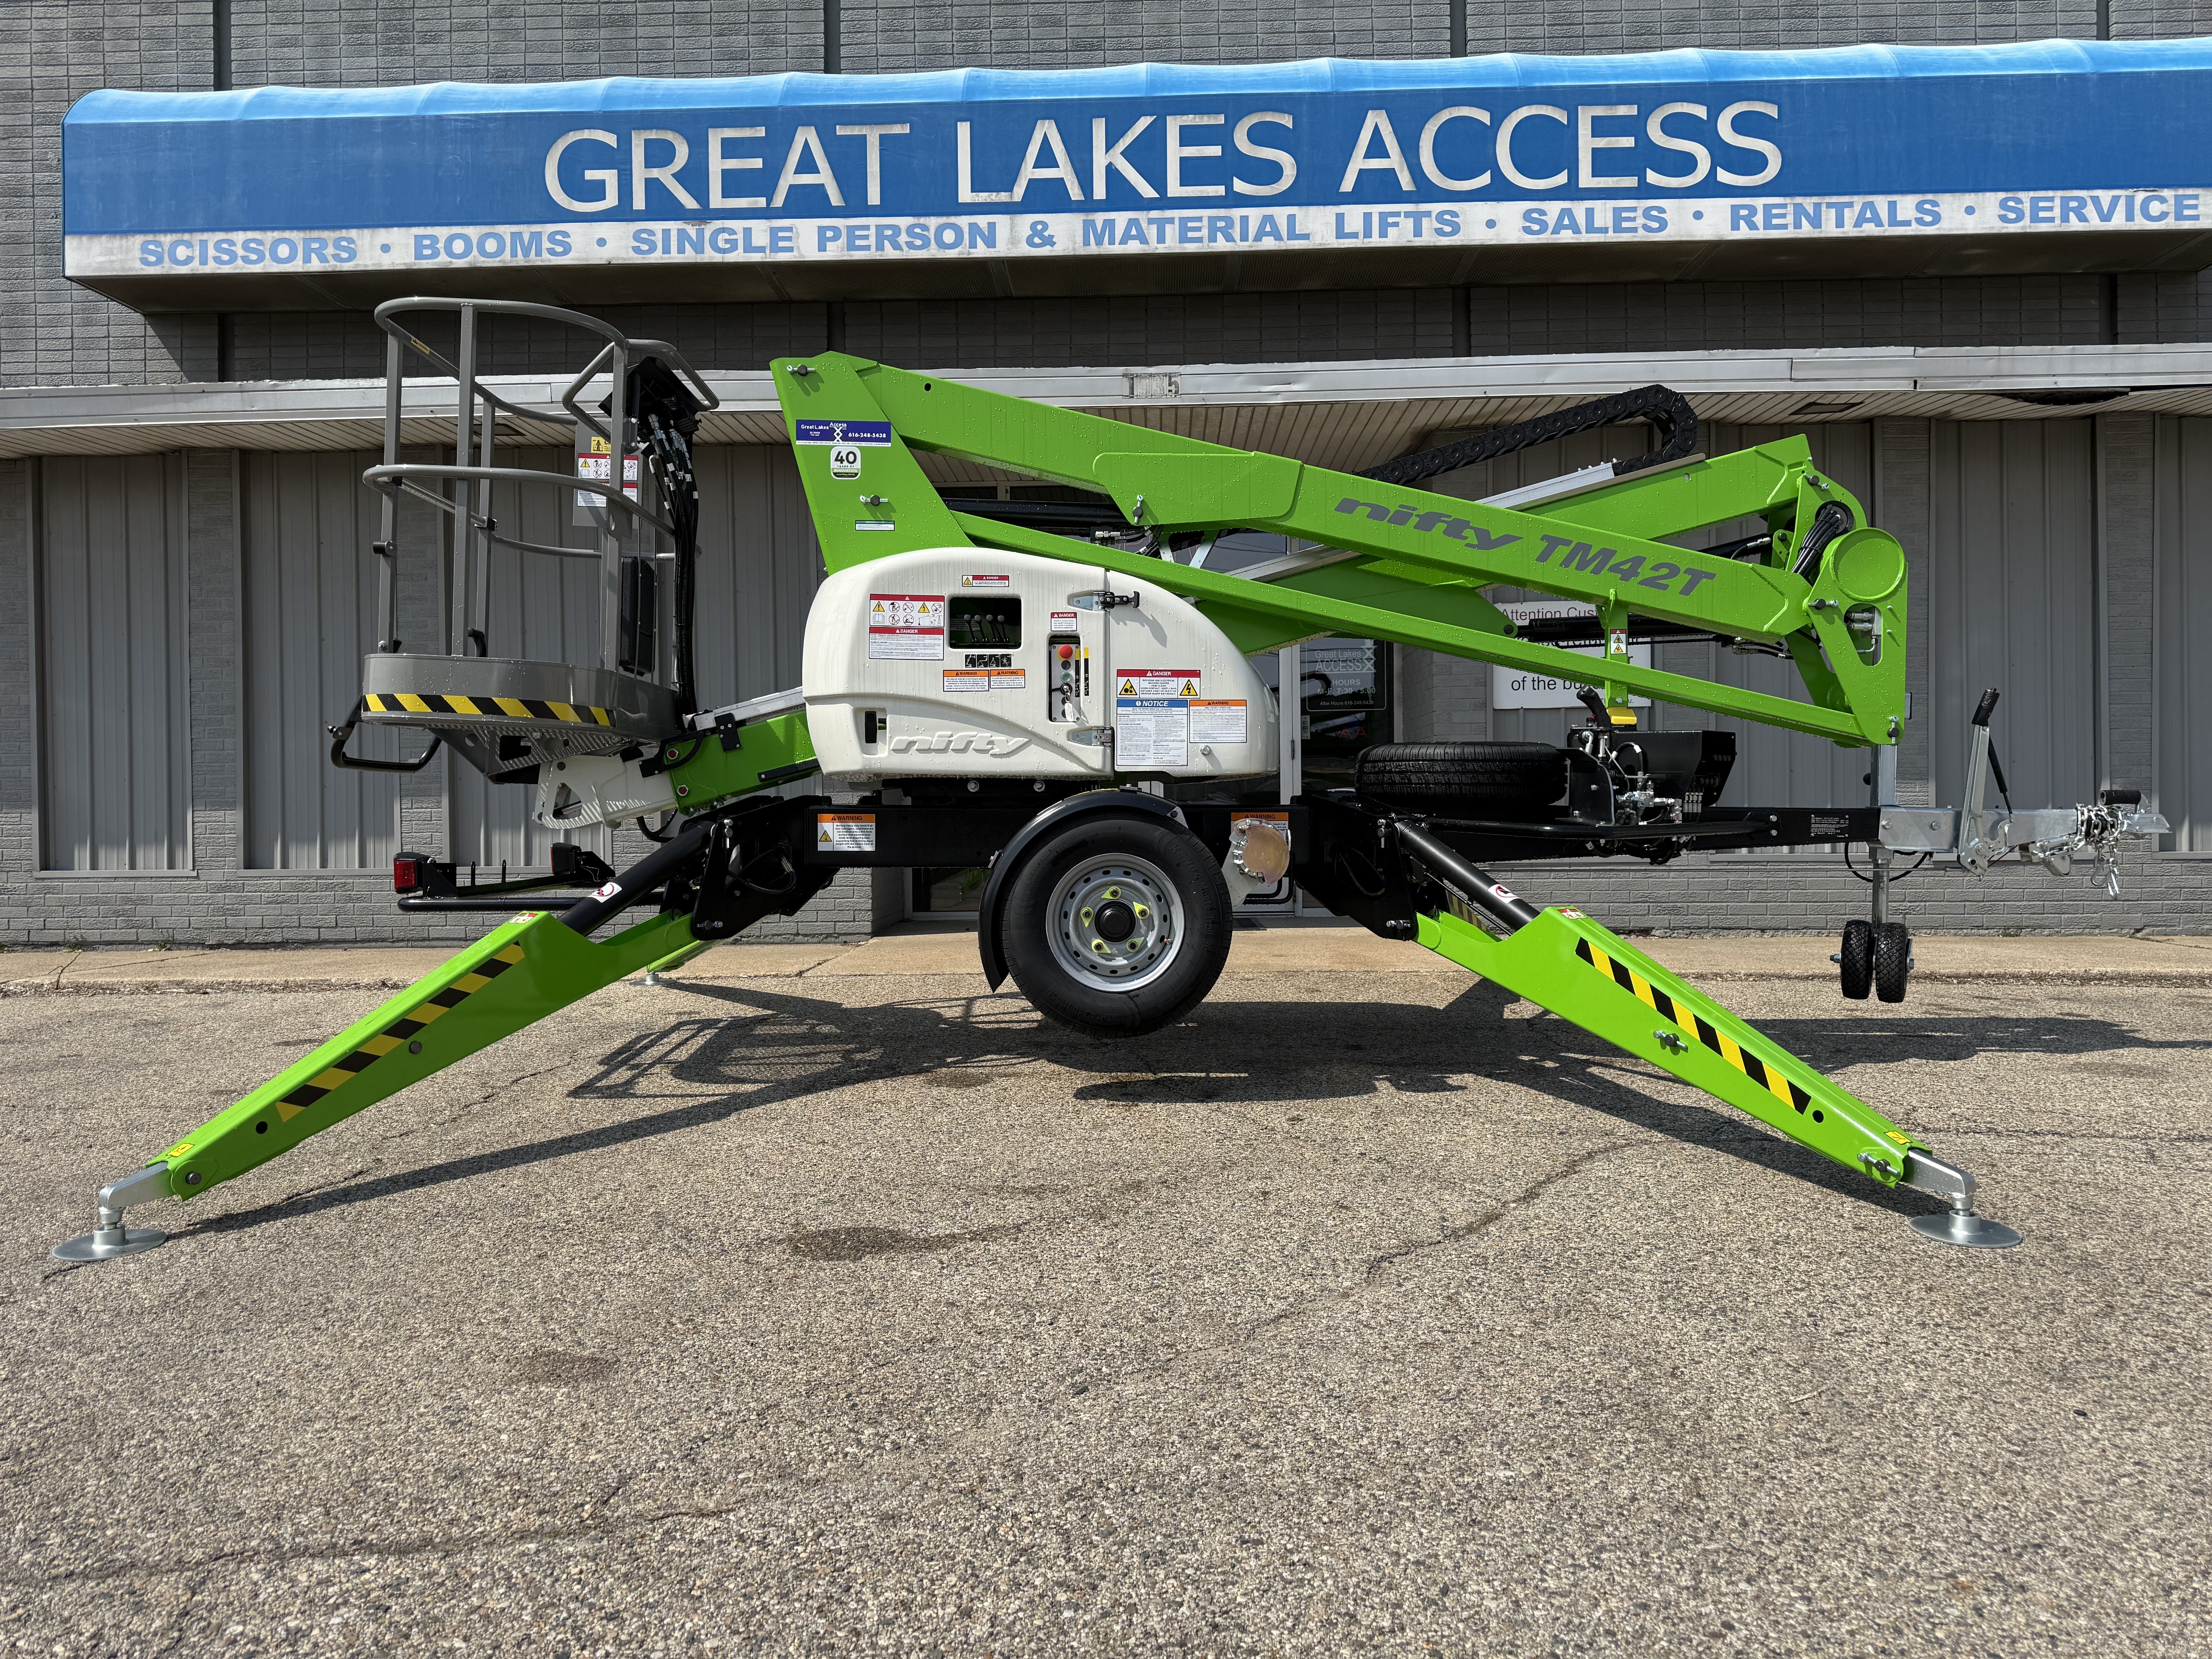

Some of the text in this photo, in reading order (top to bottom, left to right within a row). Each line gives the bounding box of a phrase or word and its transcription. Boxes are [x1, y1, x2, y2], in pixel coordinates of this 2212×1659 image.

[544, 101, 1782, 212] GREAT LAKES ACCESS
[139, 194, 2200, 266] SCISSORS BOOMS SINGLE PERSON & MATERIAL LIFTS SALES RENTALS SERVICE
[1128, 374, 1179, 397] 1935
[835, 451, 857, 464] 40
[1334, 497, 1717, 596] nifty TM42T
[1502, 608, 1561, 620] Attention
[1315, 650, 1337, 658] Great
[1316, 659, 1362, 672] ACCESS
[1511, 676, 1527, 690] of
[1532, 676, 1557, 690] the
[890, 731, 1032, 759] nifty
[1170, 845, 1203, 884] KENDA
